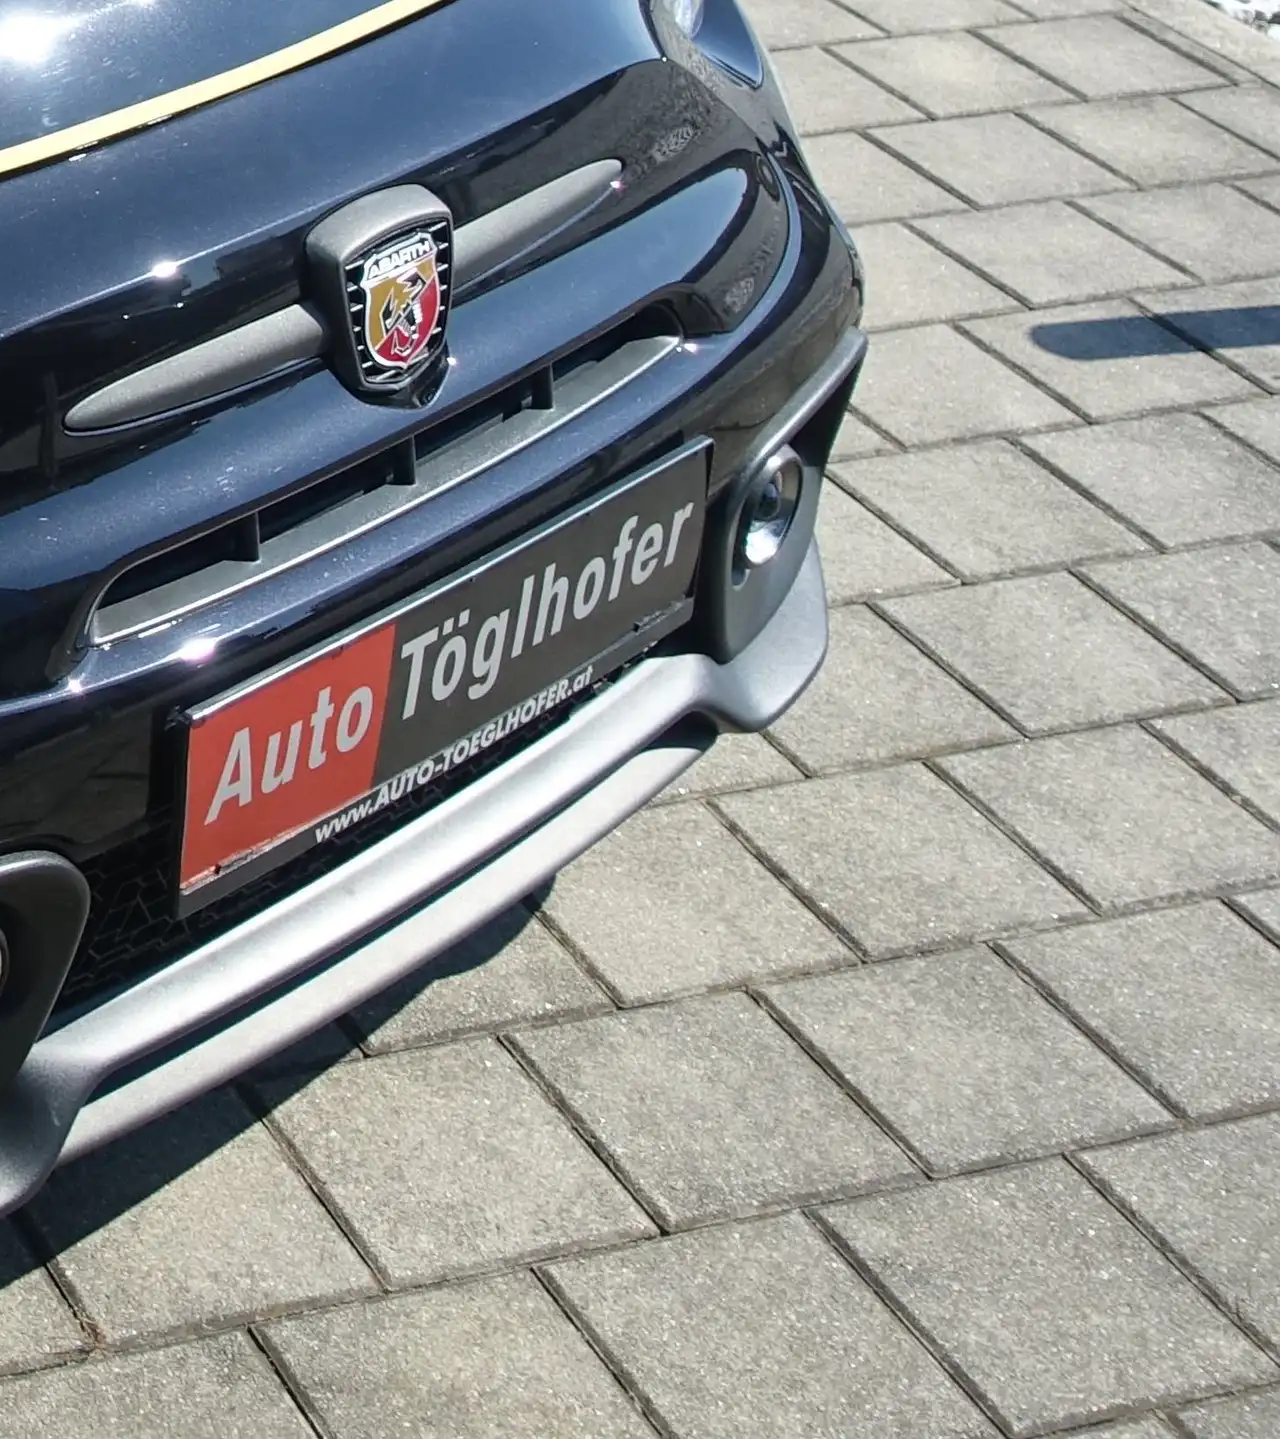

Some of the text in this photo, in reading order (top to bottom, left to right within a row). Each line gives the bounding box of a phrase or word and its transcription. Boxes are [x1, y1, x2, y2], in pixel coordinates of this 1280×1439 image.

[368, 242, 430, 278] ABARTH
[204, 501, 694, 826] Auto Töglhofer
[315, 663, 594, 843] www.AUTO-TOEGLHOFER.at
